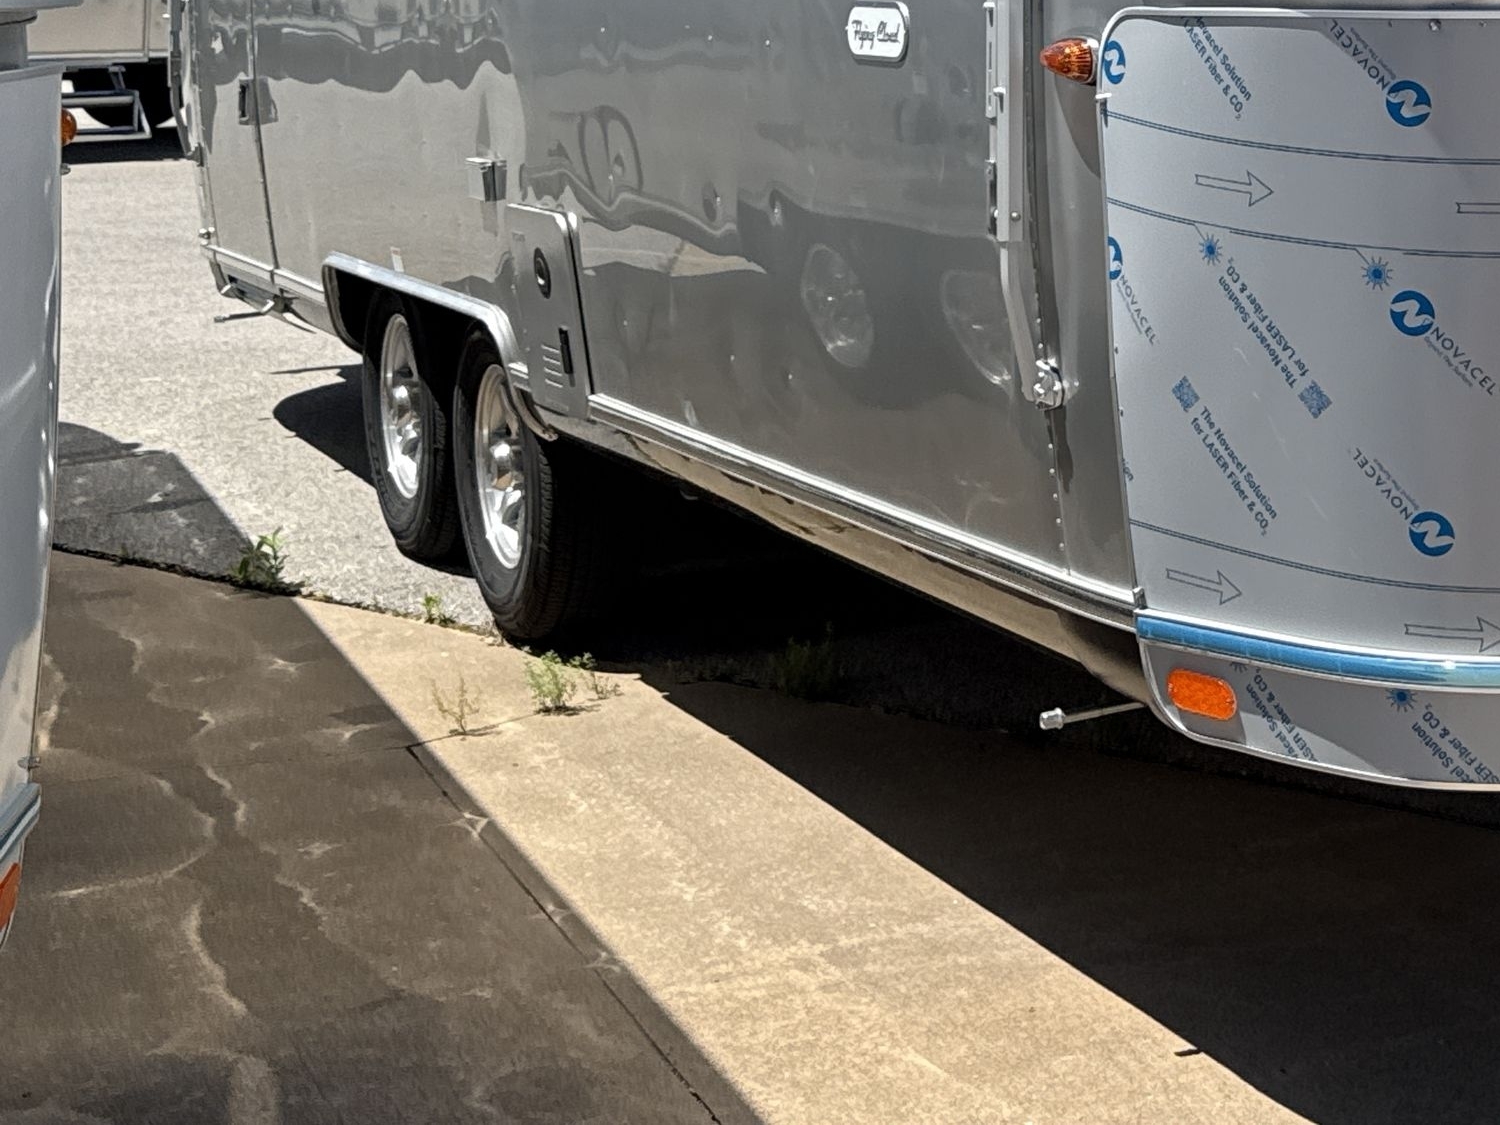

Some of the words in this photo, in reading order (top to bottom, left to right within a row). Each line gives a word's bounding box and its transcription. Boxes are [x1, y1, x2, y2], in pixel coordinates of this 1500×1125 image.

[1204, 56, 1224, 85] Fiber
[1222, 84, 1231, 96] &
[1220, 53, 1252, 101] Solution
[1330, 19, 1391, 91] NOVACEL
[1119, 275, 1156, 345] NOVACEL
[1218, 276, 1250, 323] Solution
[1239, 282, 1248, 294] &
[1246, 293, 1269, 323] Fiber
[1247, 321, 1282, 367] Novacel
[1265, 320, 1296, 360] LASER
[1430, 326, 1496, 396] NOVACEL
[1280, 364, 1297, 389] The
[1294, 358, 1309, 377] for
[1191, 417, 1204, 435] for
[1202, 434, 1229, 473] LASER
[1227, 471, 1249, 502] Fiber
[1247, 500, 1256, 513] &
[1200, 406, 1215, 429] The
[1214, 428, 1246, 473] Novacel
[1244, 472, 1277, 519] Solution
[1353, 447, 1413, 520] NOVACEL
[1246, 683, 1278, 732] Solution
[1266, 691, 1275, 703] &
[1273, 703, 1296, 734] Fiber
[1411, 721, 1454, 769] Solution
[1439, 726, 1450, 739] &
[1448, 737, 1477, 766] Fiber
